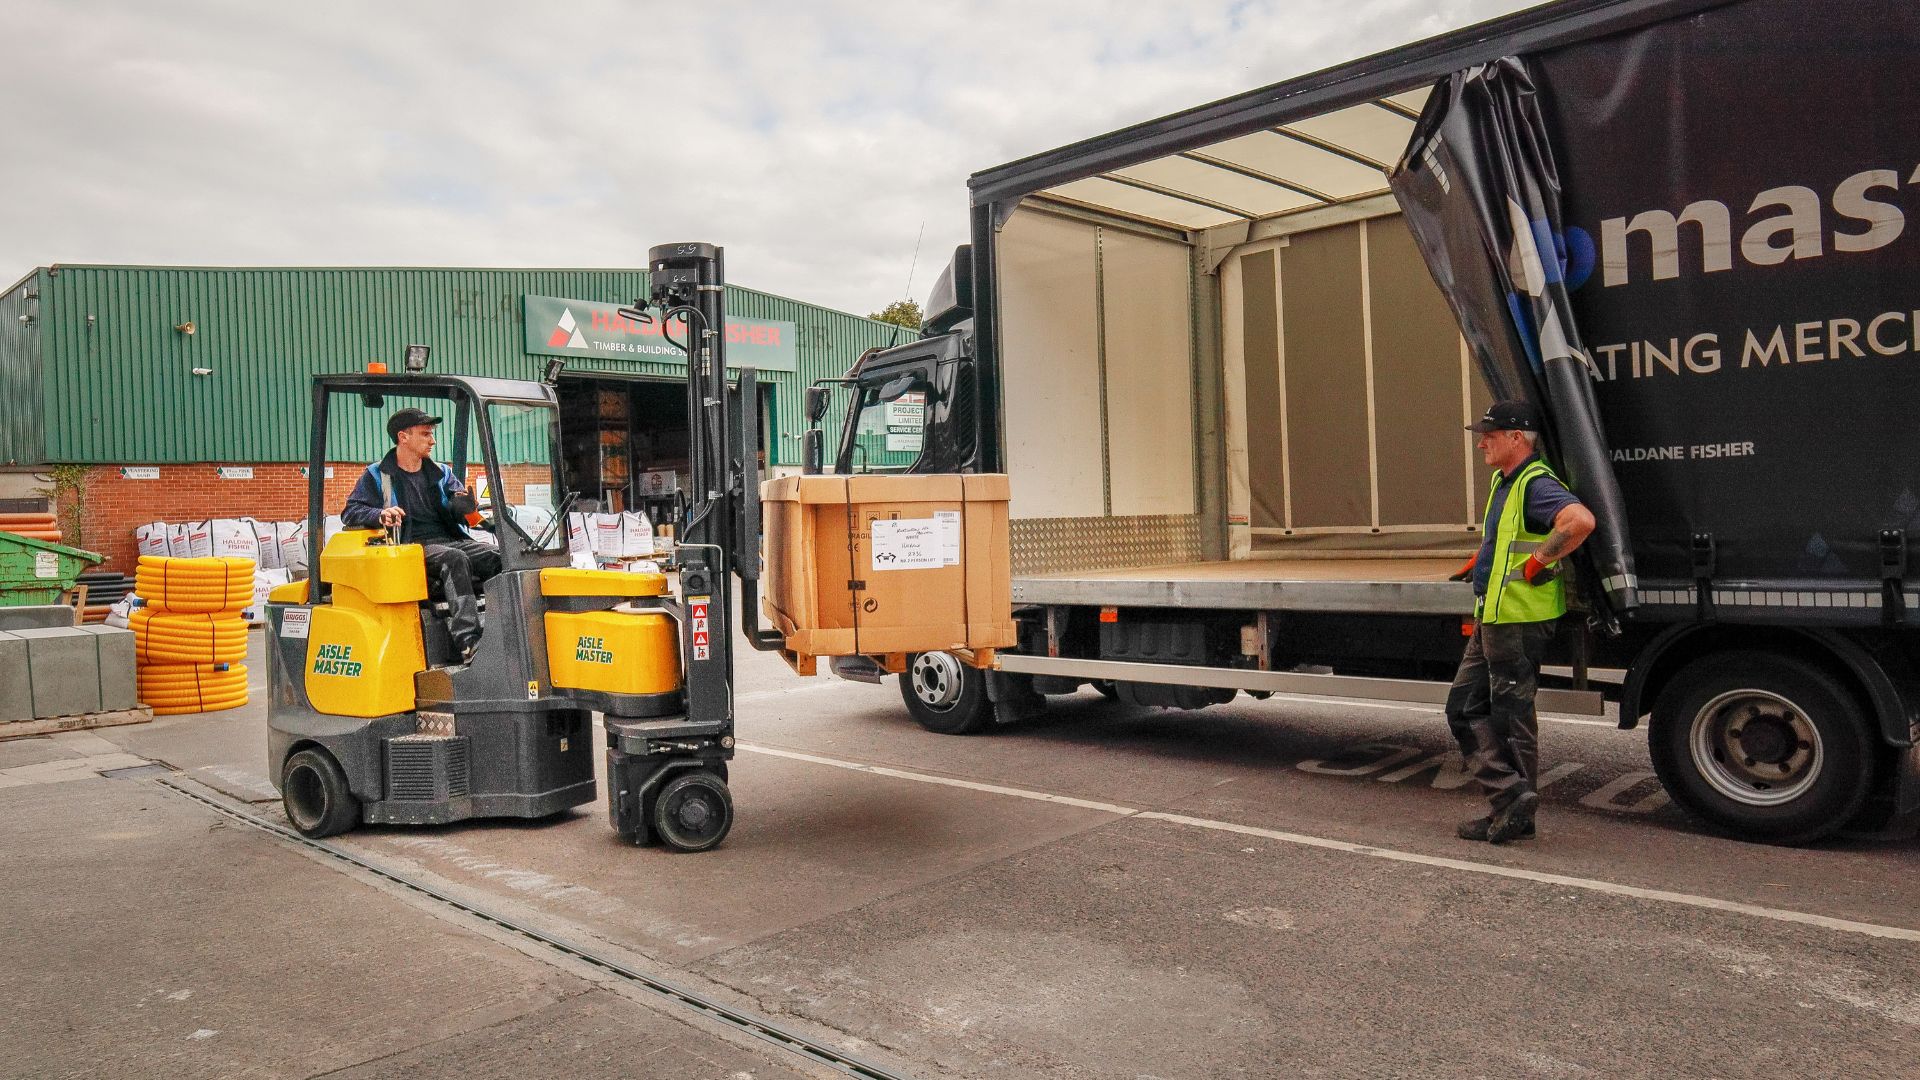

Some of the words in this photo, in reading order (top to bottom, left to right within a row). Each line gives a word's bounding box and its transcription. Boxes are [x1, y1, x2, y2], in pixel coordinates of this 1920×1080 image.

[591, 310, 688, 337] HALDAN
[725, 321, 781, 347] ISHER
[1741, 310, 1920, 369] MERC
[593, 341, 627, 352] TIMBER
[628, 344, 635, 353] &
[637, 344, 676, 356] BUILDING
[1609, 446, 1685, 462] ALDANE
[1690, 441, 1756, 460] FISHER
[285, 613, 306, 621] BRIGGS
[575, 648, 614, 664] MASTER
[313, 660, 363, 677] MASTER
